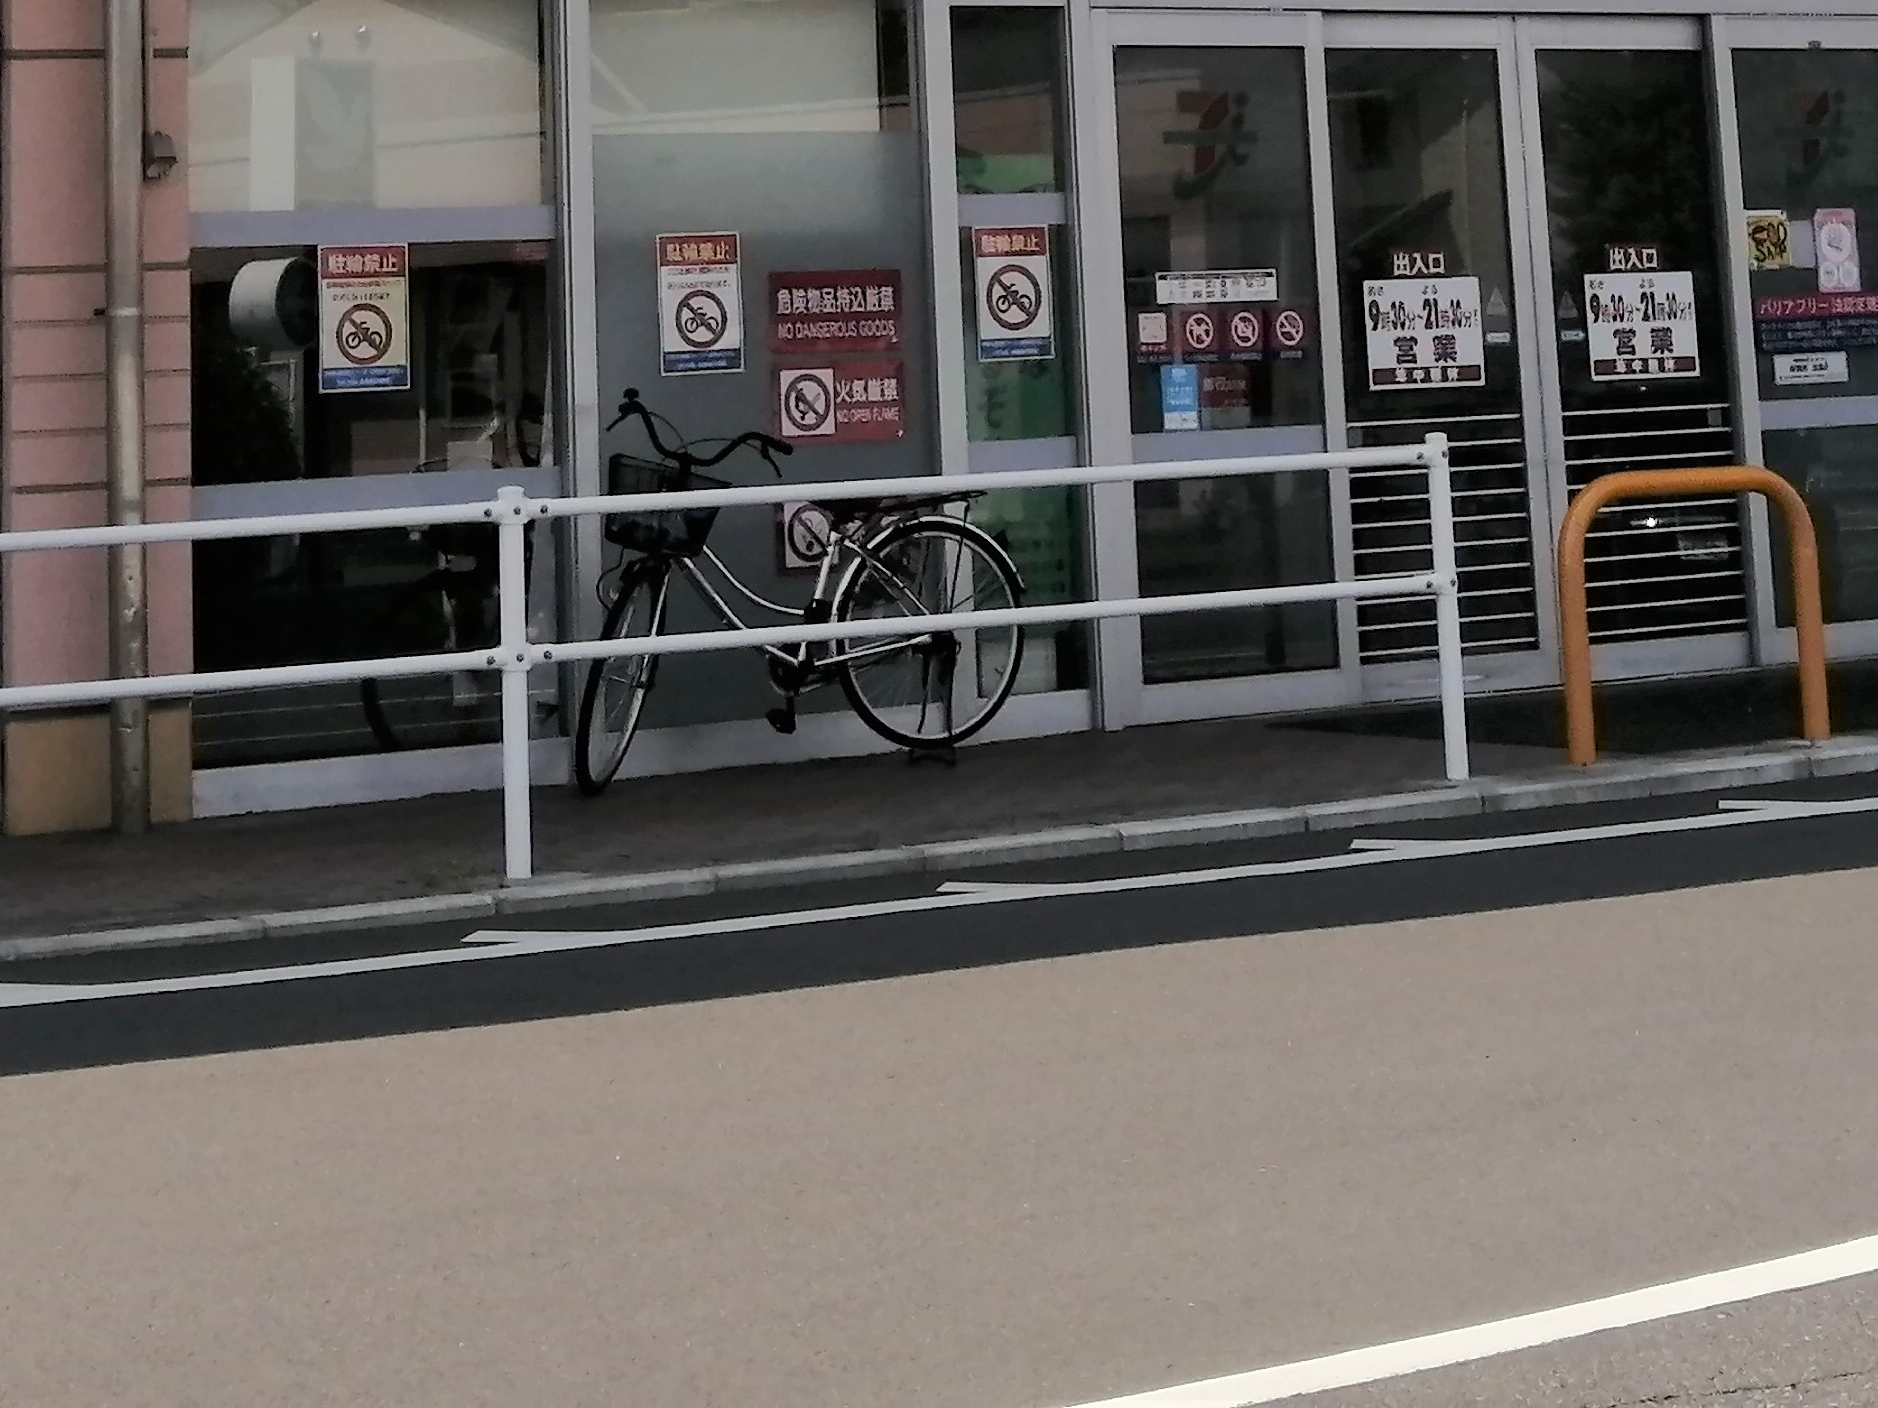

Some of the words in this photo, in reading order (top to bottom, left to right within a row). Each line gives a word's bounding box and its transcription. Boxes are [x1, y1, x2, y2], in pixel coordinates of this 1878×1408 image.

[1393, 251, 1445, 276] 出入口
[1609, 246, 1658, 270] 出入口
[778, 322, 794, 341] NO
[795, 320, 857, 339] DANGEROUS
[859, 318, 897, 337] GOODS
[1612, 326, 1674, 356] 営業
[1393, 334, 1457, 365] 営業
